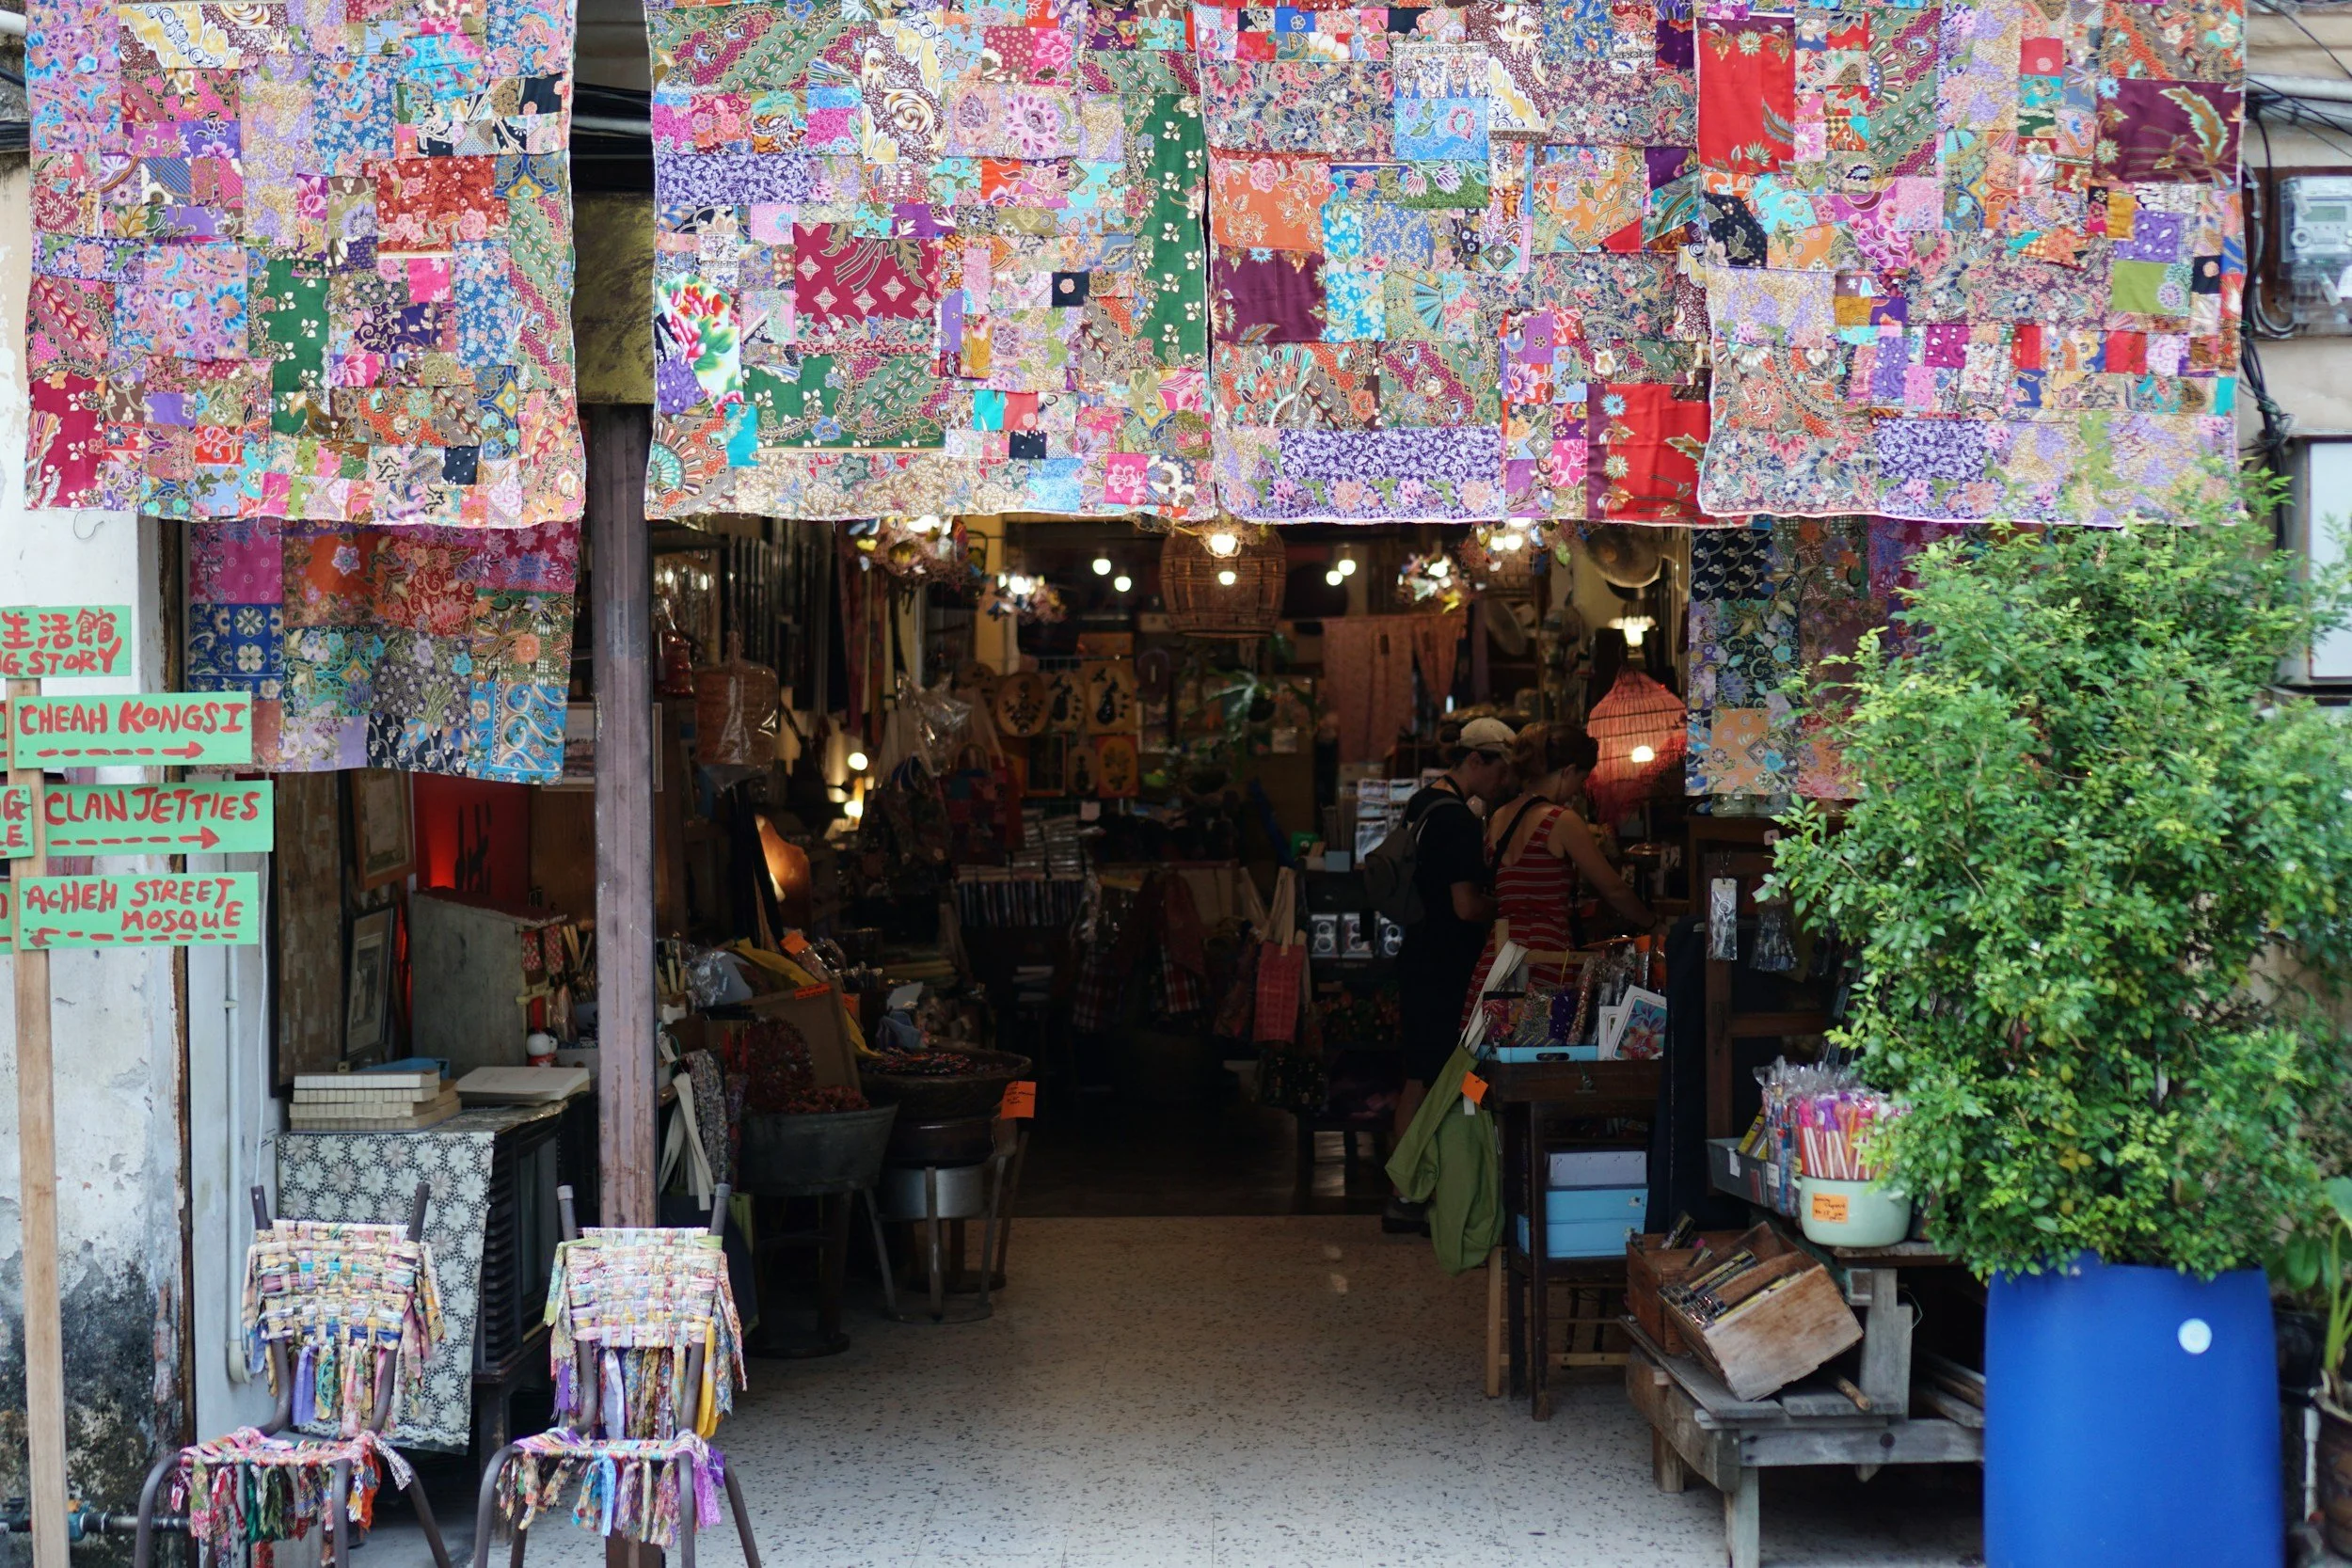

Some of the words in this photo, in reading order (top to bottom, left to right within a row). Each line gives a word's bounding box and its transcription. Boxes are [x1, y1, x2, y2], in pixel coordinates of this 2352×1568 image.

[1, 608, 117, 650] 生活館
[26, 636, 122, 675] STORY
[20, 703, 108, 735] CHEAH
[118, 701, 247, 735] KONGSI
[45, 789, 128, 826] CLAN
[132, 786, 261, 823] JETTIES
[26, 879, 118, 914] ACHEH
[130, 878, 235, 909] STREET
